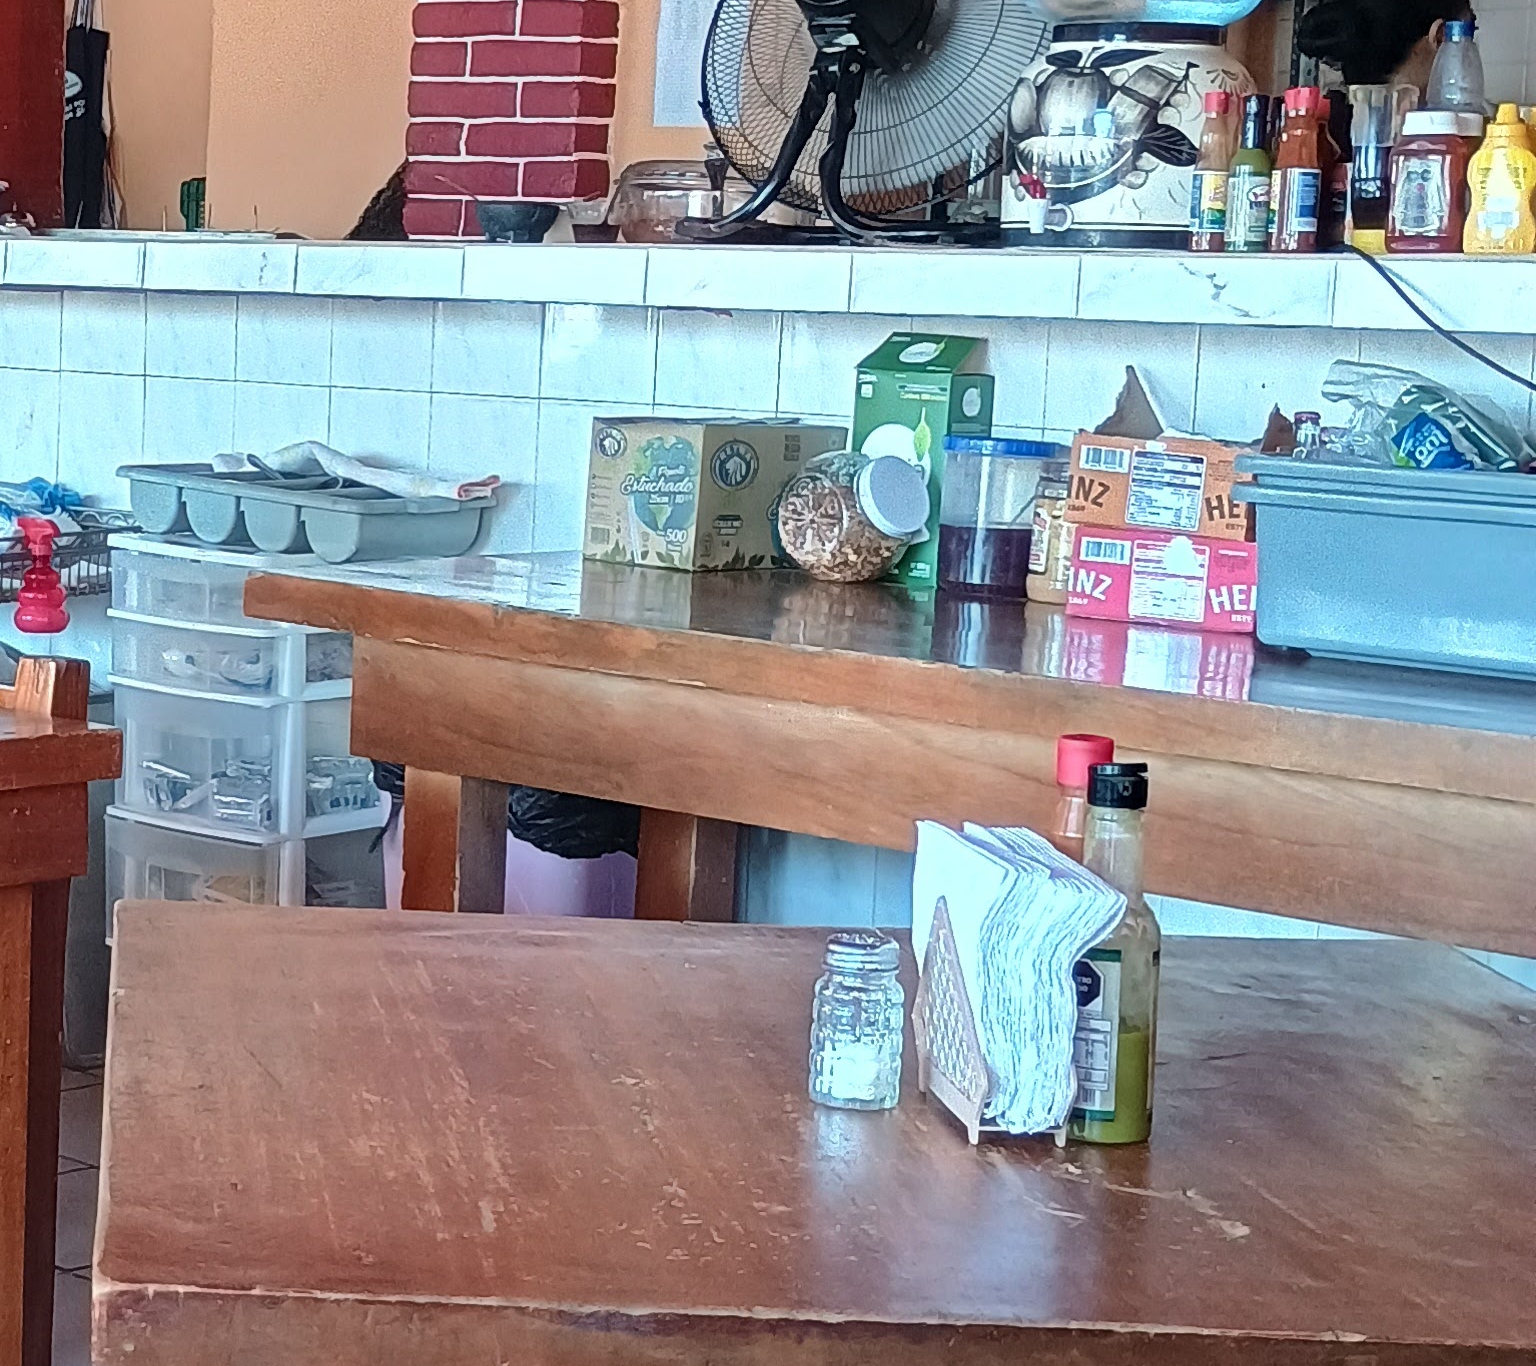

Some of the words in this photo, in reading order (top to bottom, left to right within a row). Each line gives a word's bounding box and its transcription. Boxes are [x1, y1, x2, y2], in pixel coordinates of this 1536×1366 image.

[621, 475, 694, 495] Estuchado
[1204, 494, 1247, 521] HE
[665, 529, 687, 542] 500
